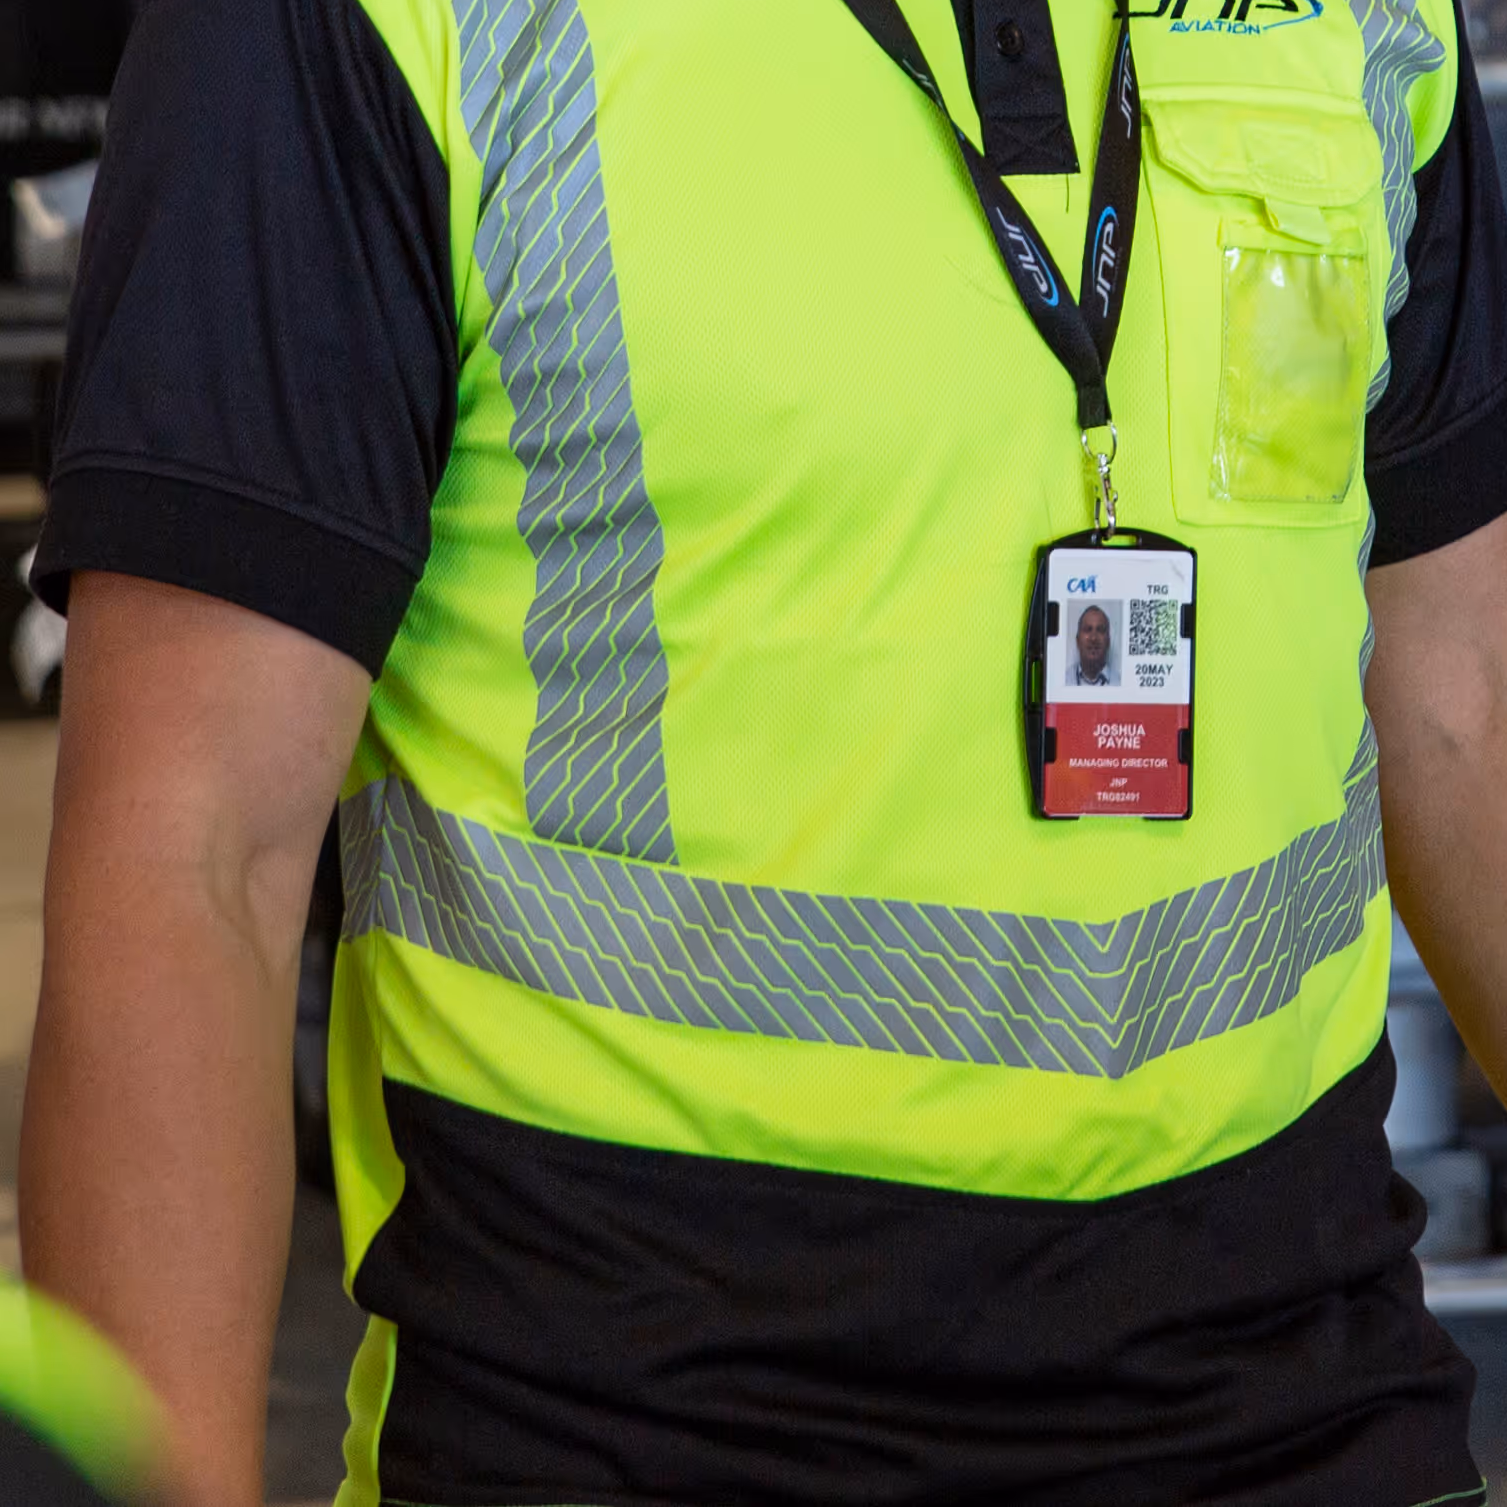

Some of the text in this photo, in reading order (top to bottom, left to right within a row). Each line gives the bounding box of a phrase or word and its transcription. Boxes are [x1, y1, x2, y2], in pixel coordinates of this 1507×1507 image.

[1168, 19, 1262, 35] AVIATION
[1147, 585, 1169, 595] TRG
[1135, 663, 1174, 675] 20MAY
[1139, 676, 1165, 687] 2023
[1093, 723, 1146, 736] JOSHUA
[1097, 737, 1141, 749] PAYNE
[1069, 758, 1168, 768] MANAGING DIRECTOR
[1109, 777, 1128, 787] JNP
